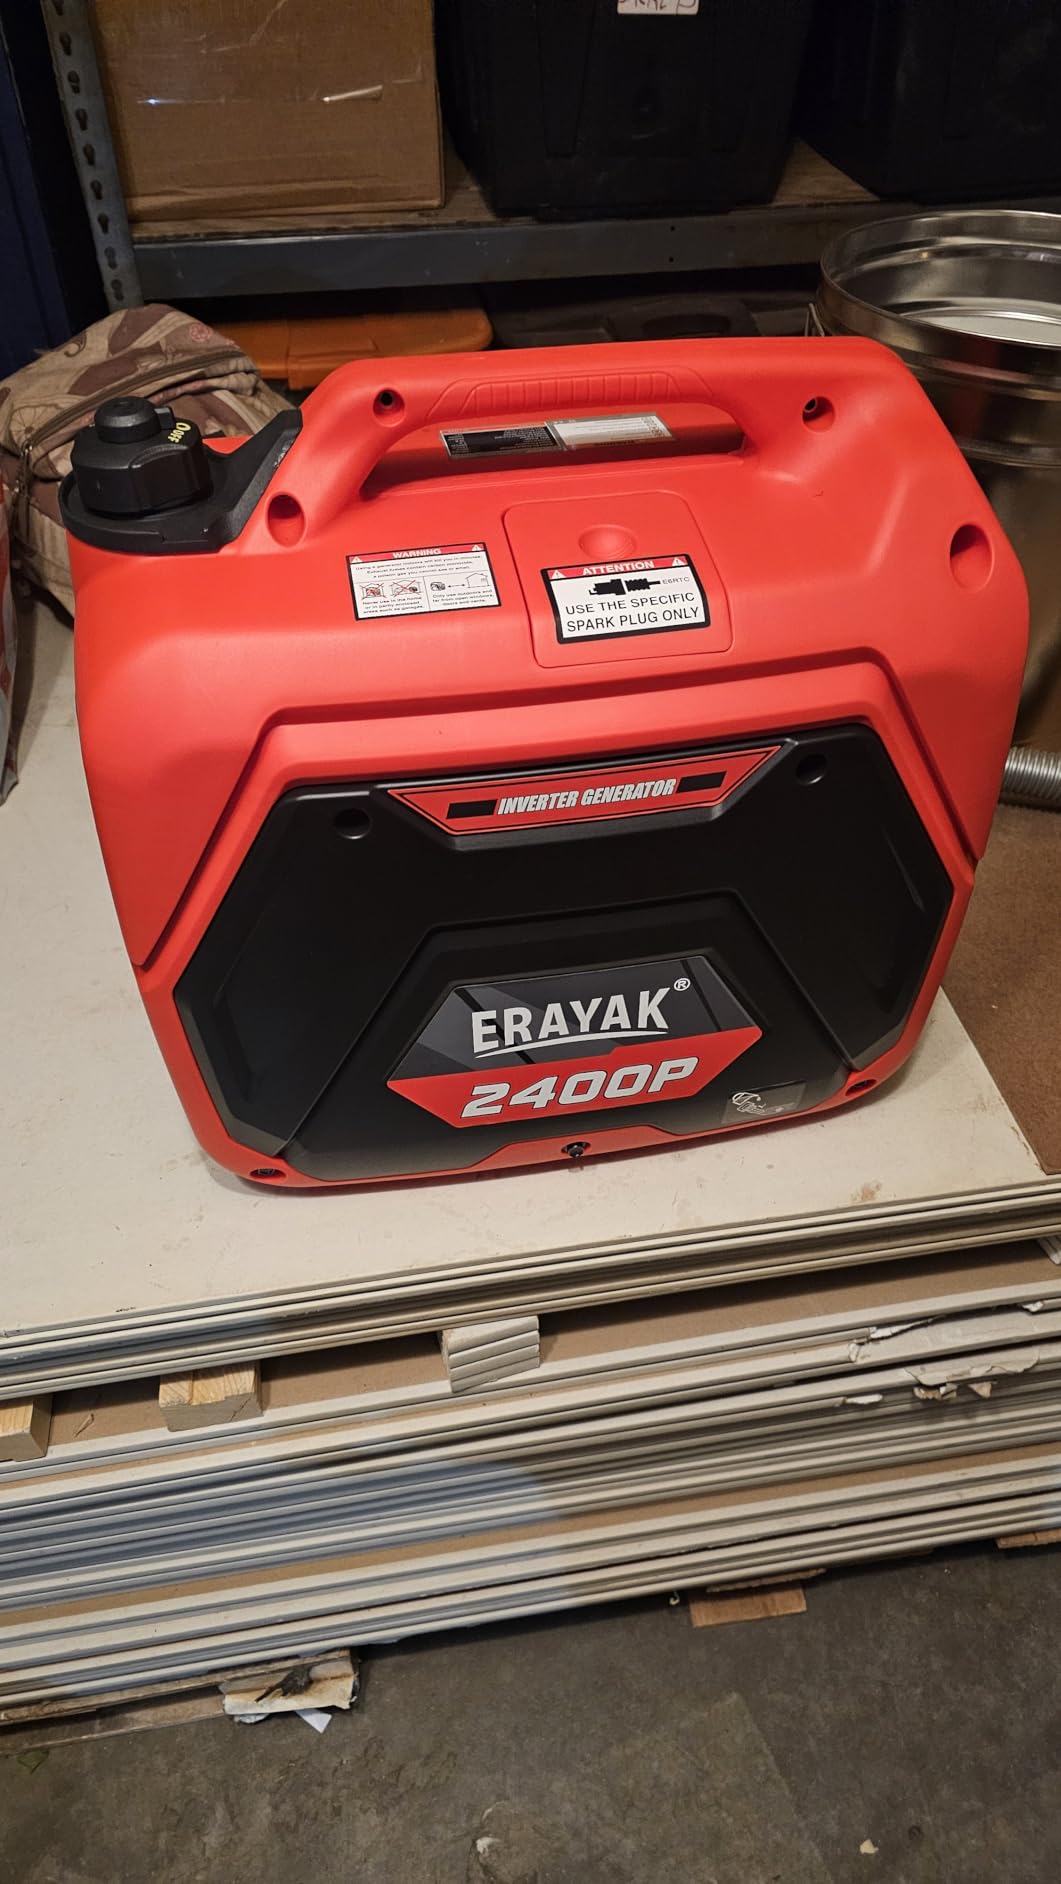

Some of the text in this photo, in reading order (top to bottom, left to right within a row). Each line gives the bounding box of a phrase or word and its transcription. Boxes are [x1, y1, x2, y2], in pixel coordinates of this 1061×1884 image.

[168, 429, 184, 443] OFF
[392, 548, 442, 559] WARNING
[582, 560, 655, 575] ATTENTION
[662, 576, 690, 585] E6RTC
[565, 592, 695, 615] USE THE SPECIFIC
[567, 606, 699, 632] SPARK PLUG ONLY
[497, 778, 677, 815] INVERTER GENERATOR
[460, 1056, 699, 1119] 2400P
